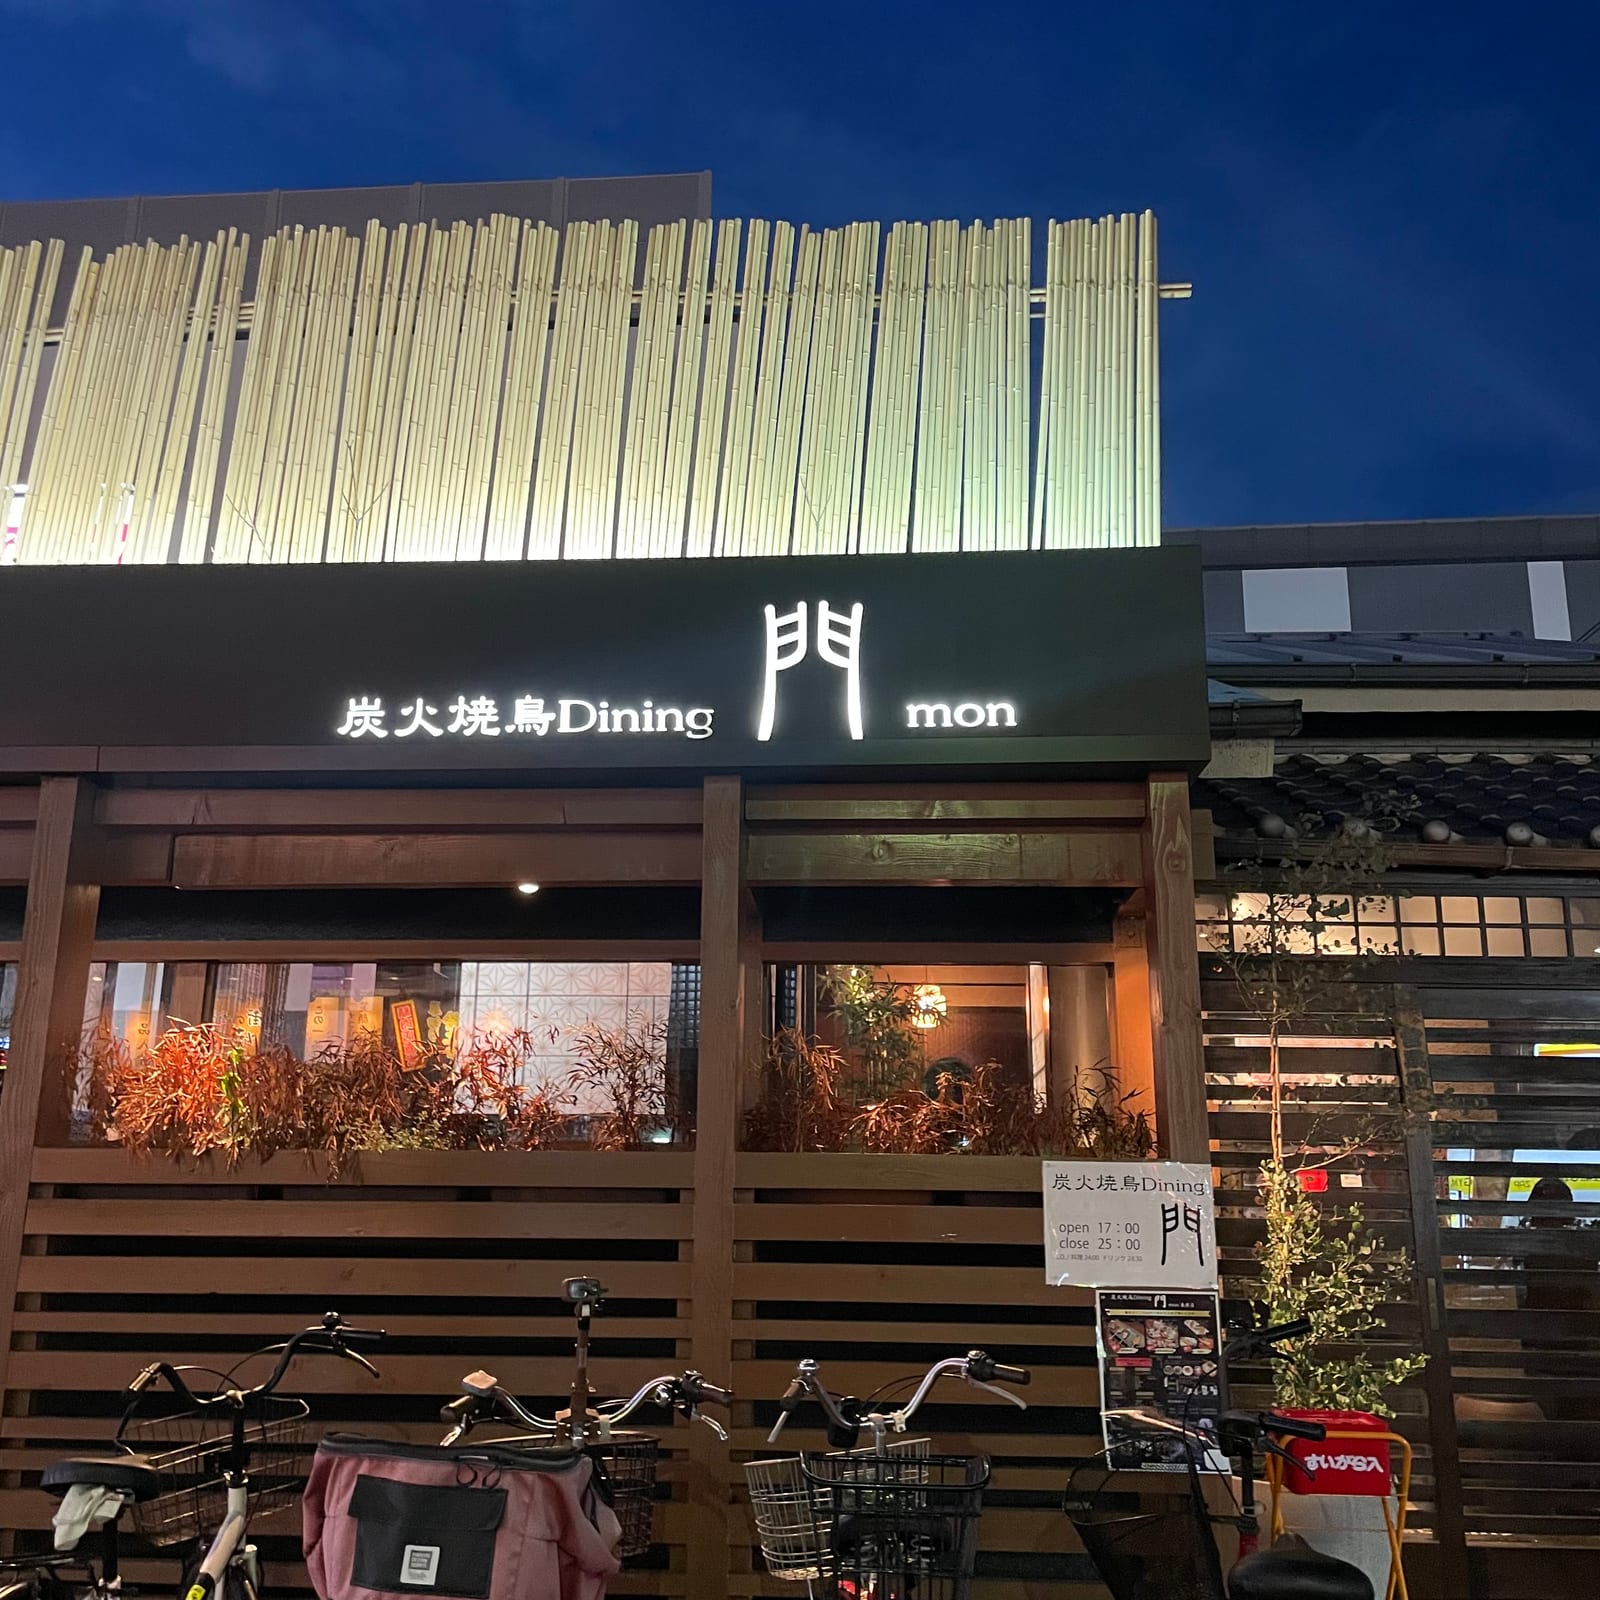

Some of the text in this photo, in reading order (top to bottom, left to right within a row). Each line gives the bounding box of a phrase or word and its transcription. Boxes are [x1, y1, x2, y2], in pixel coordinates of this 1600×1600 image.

[336, 600, 1018, 741] 炭火焼鳥Dining 門 mon
[1059, 1223, 1090, 1236] open
[1161, 1203, 1204, 1267] 門
[1059, 1237, 1090, 1249] close
[1304, 1453, 1384, 1473] すいがら入
